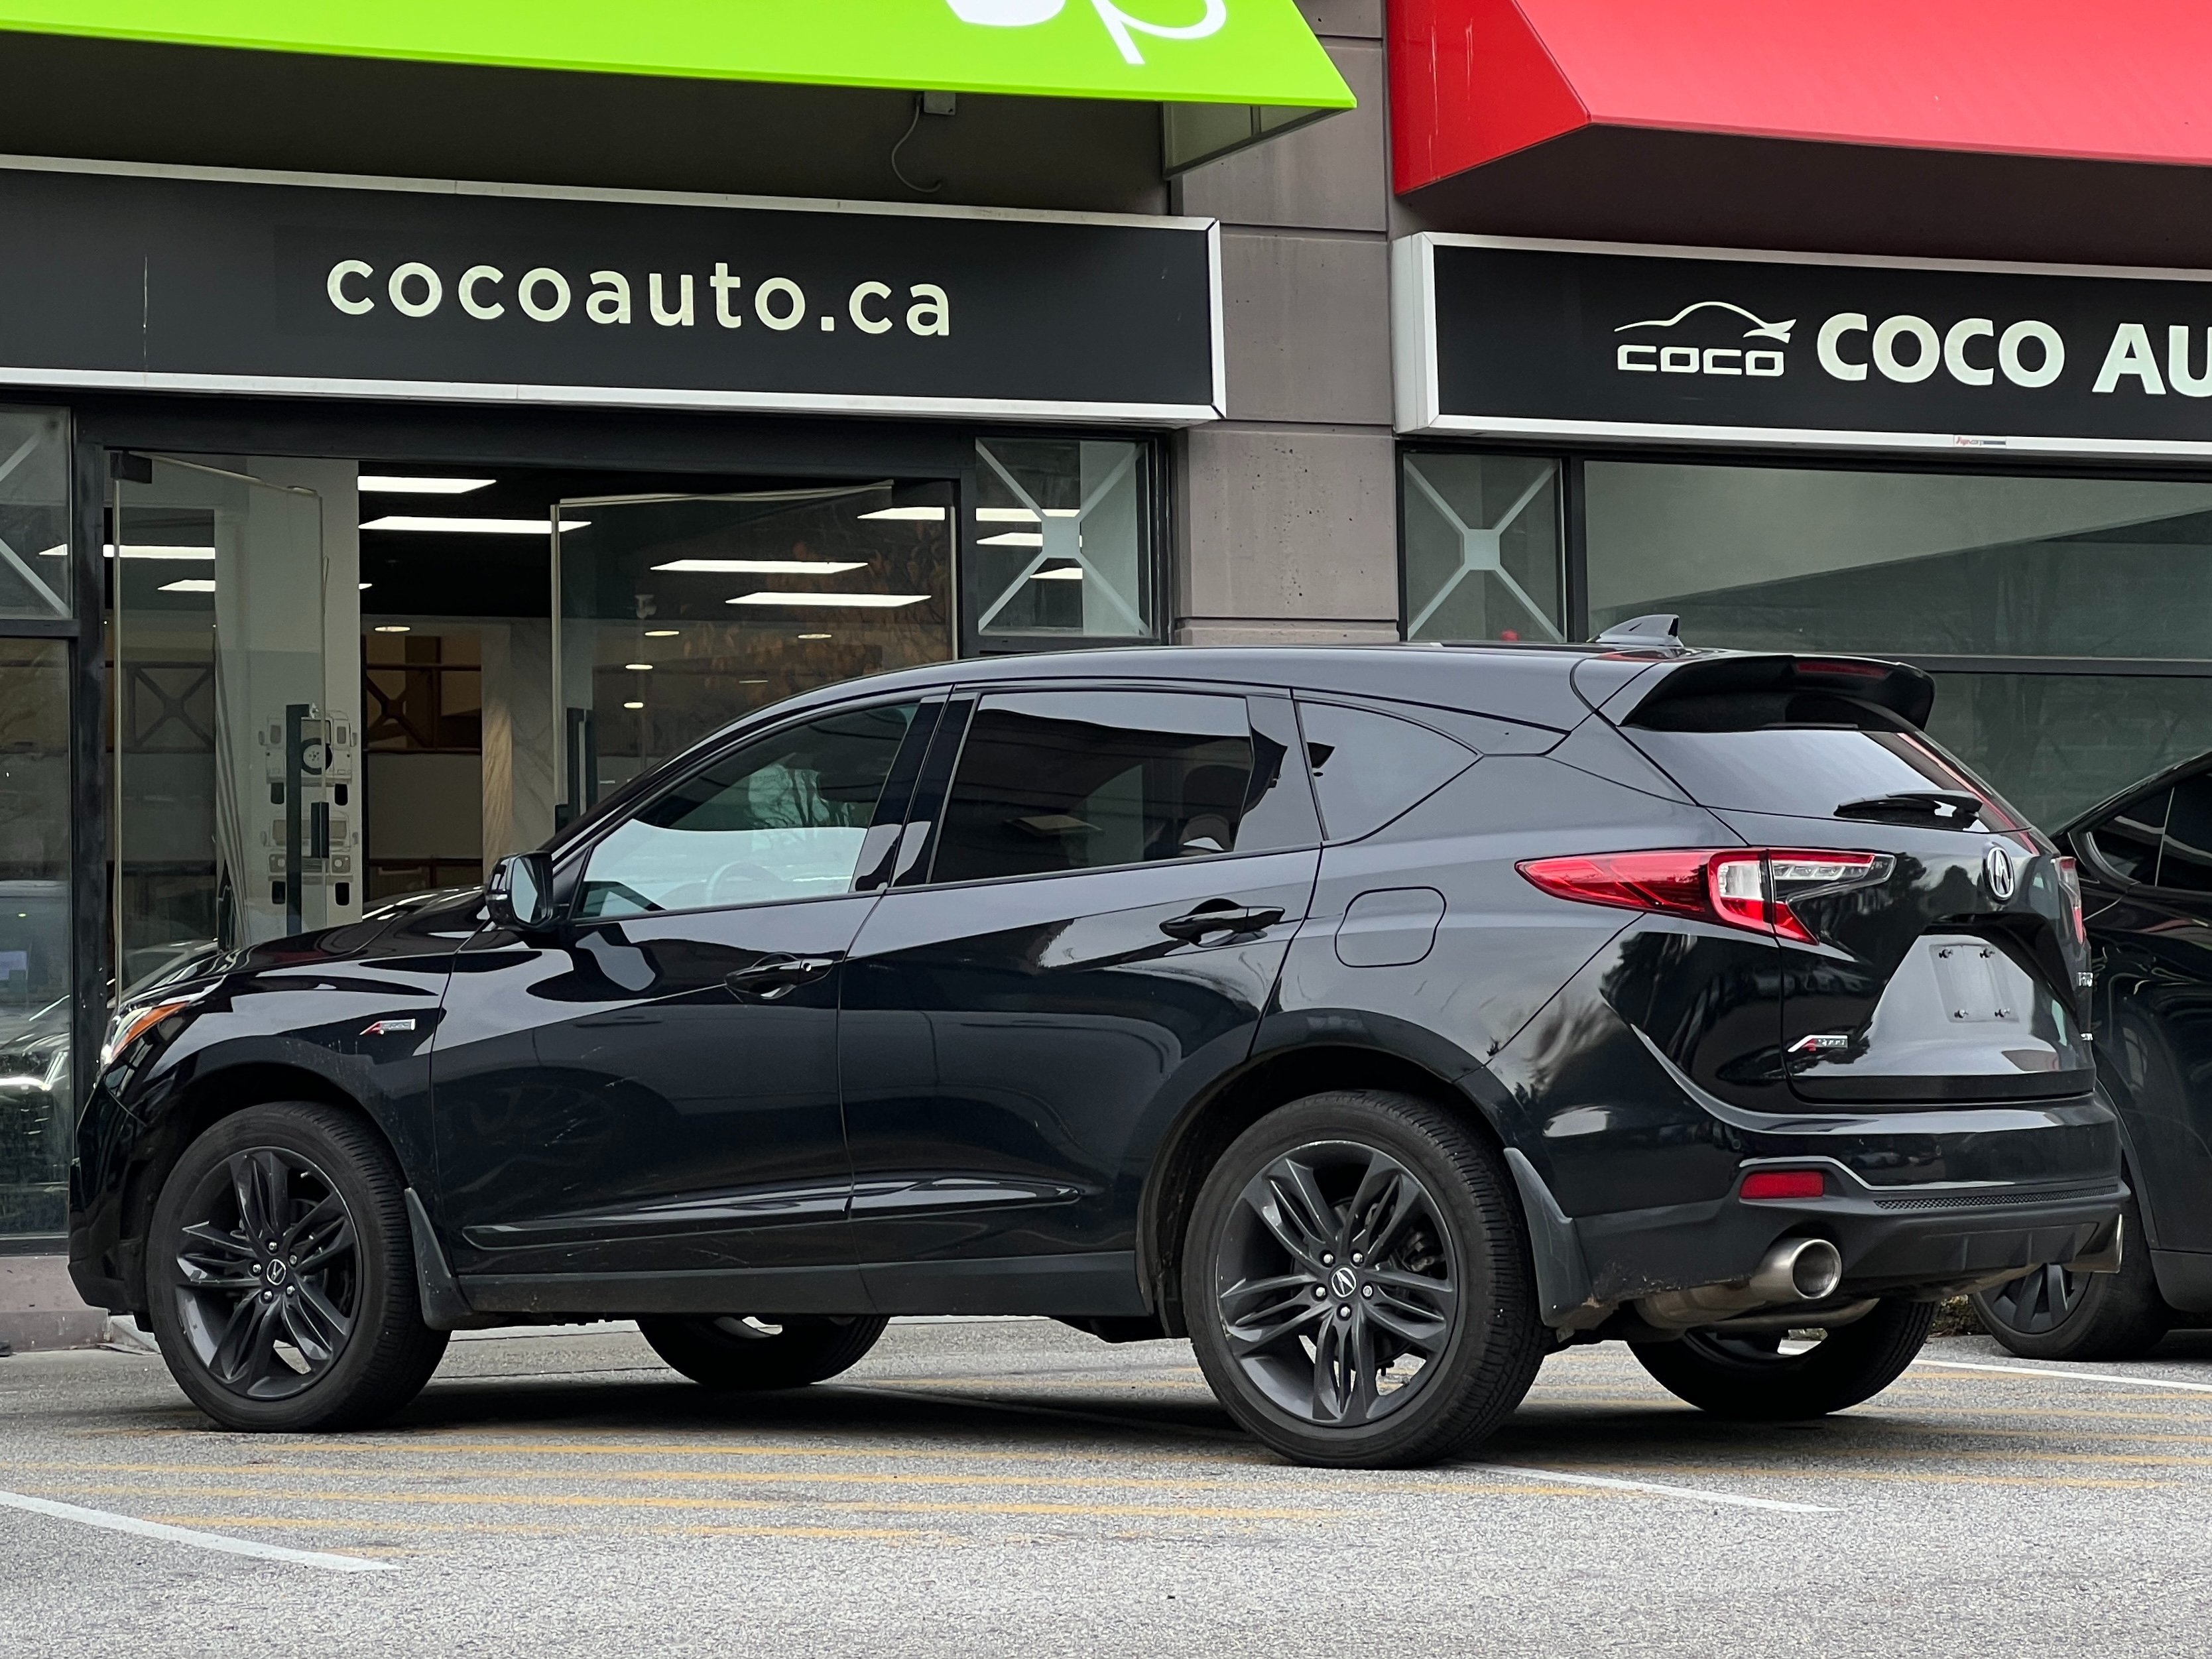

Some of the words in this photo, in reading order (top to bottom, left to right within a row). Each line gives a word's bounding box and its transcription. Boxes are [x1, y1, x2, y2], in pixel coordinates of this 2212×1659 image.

[326, 259, 950, 337] cocoauto.ca
[1617, 344, 1785, 377] COCO
[1816, 312, 2065, 389] COCO
